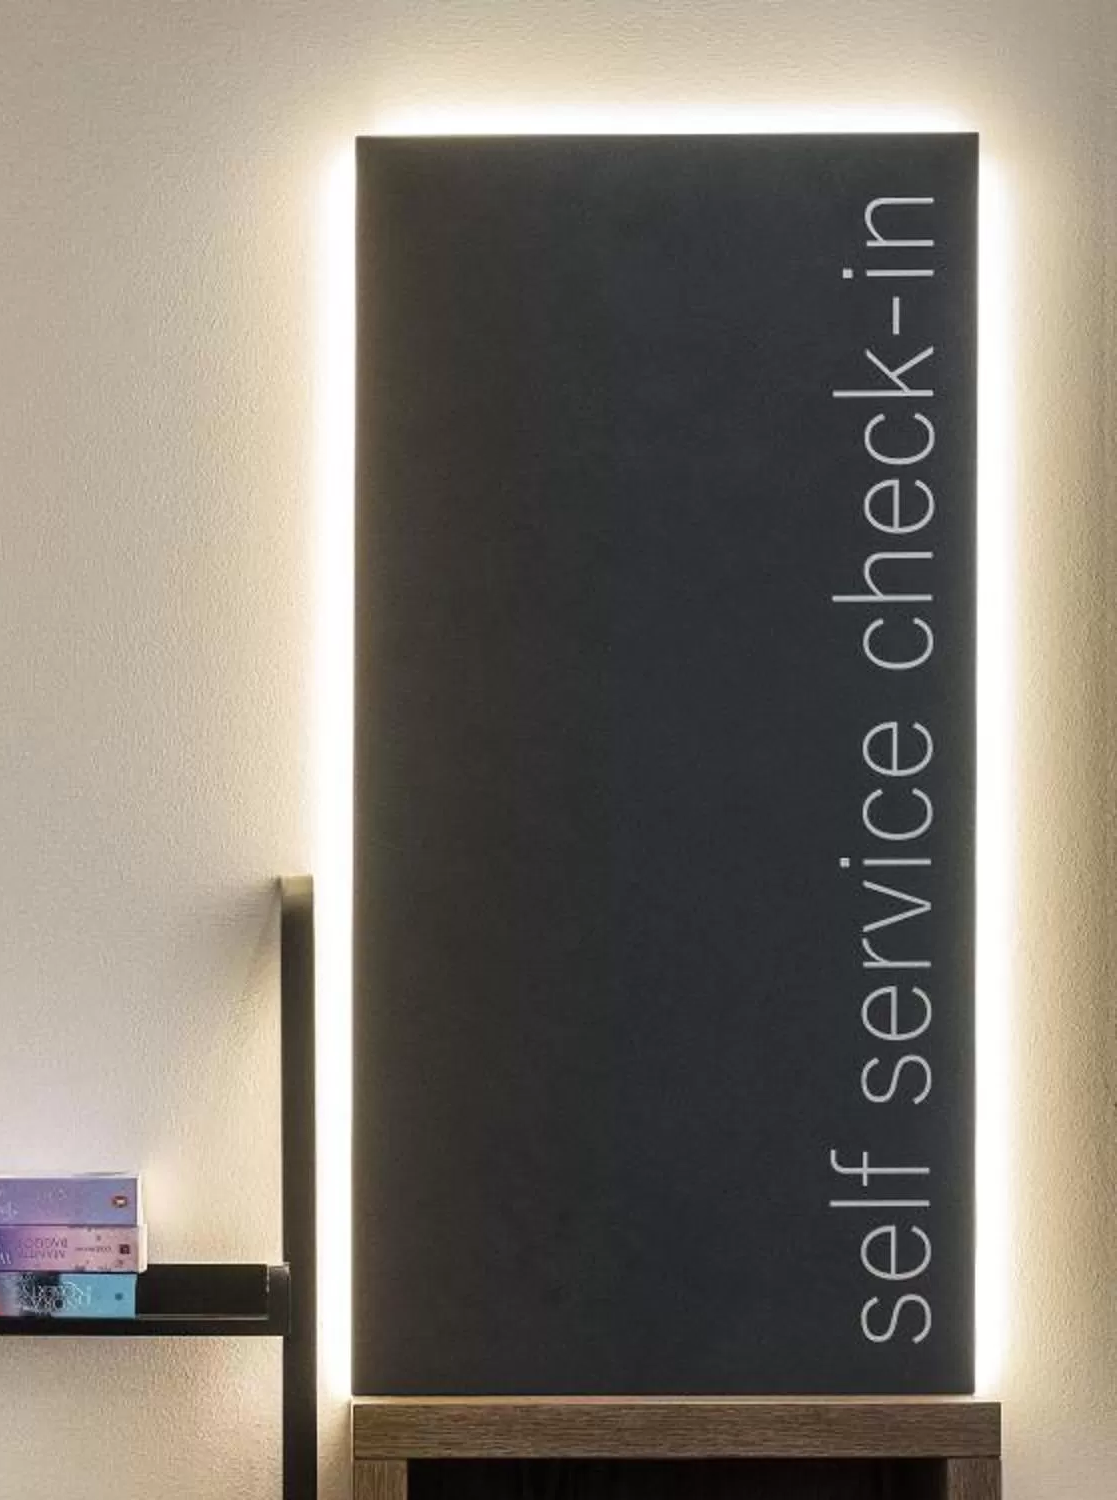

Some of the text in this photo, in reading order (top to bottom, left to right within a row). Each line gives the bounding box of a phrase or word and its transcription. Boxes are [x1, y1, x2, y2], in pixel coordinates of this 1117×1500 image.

[831, 198, 937, 1345] self service check-in
